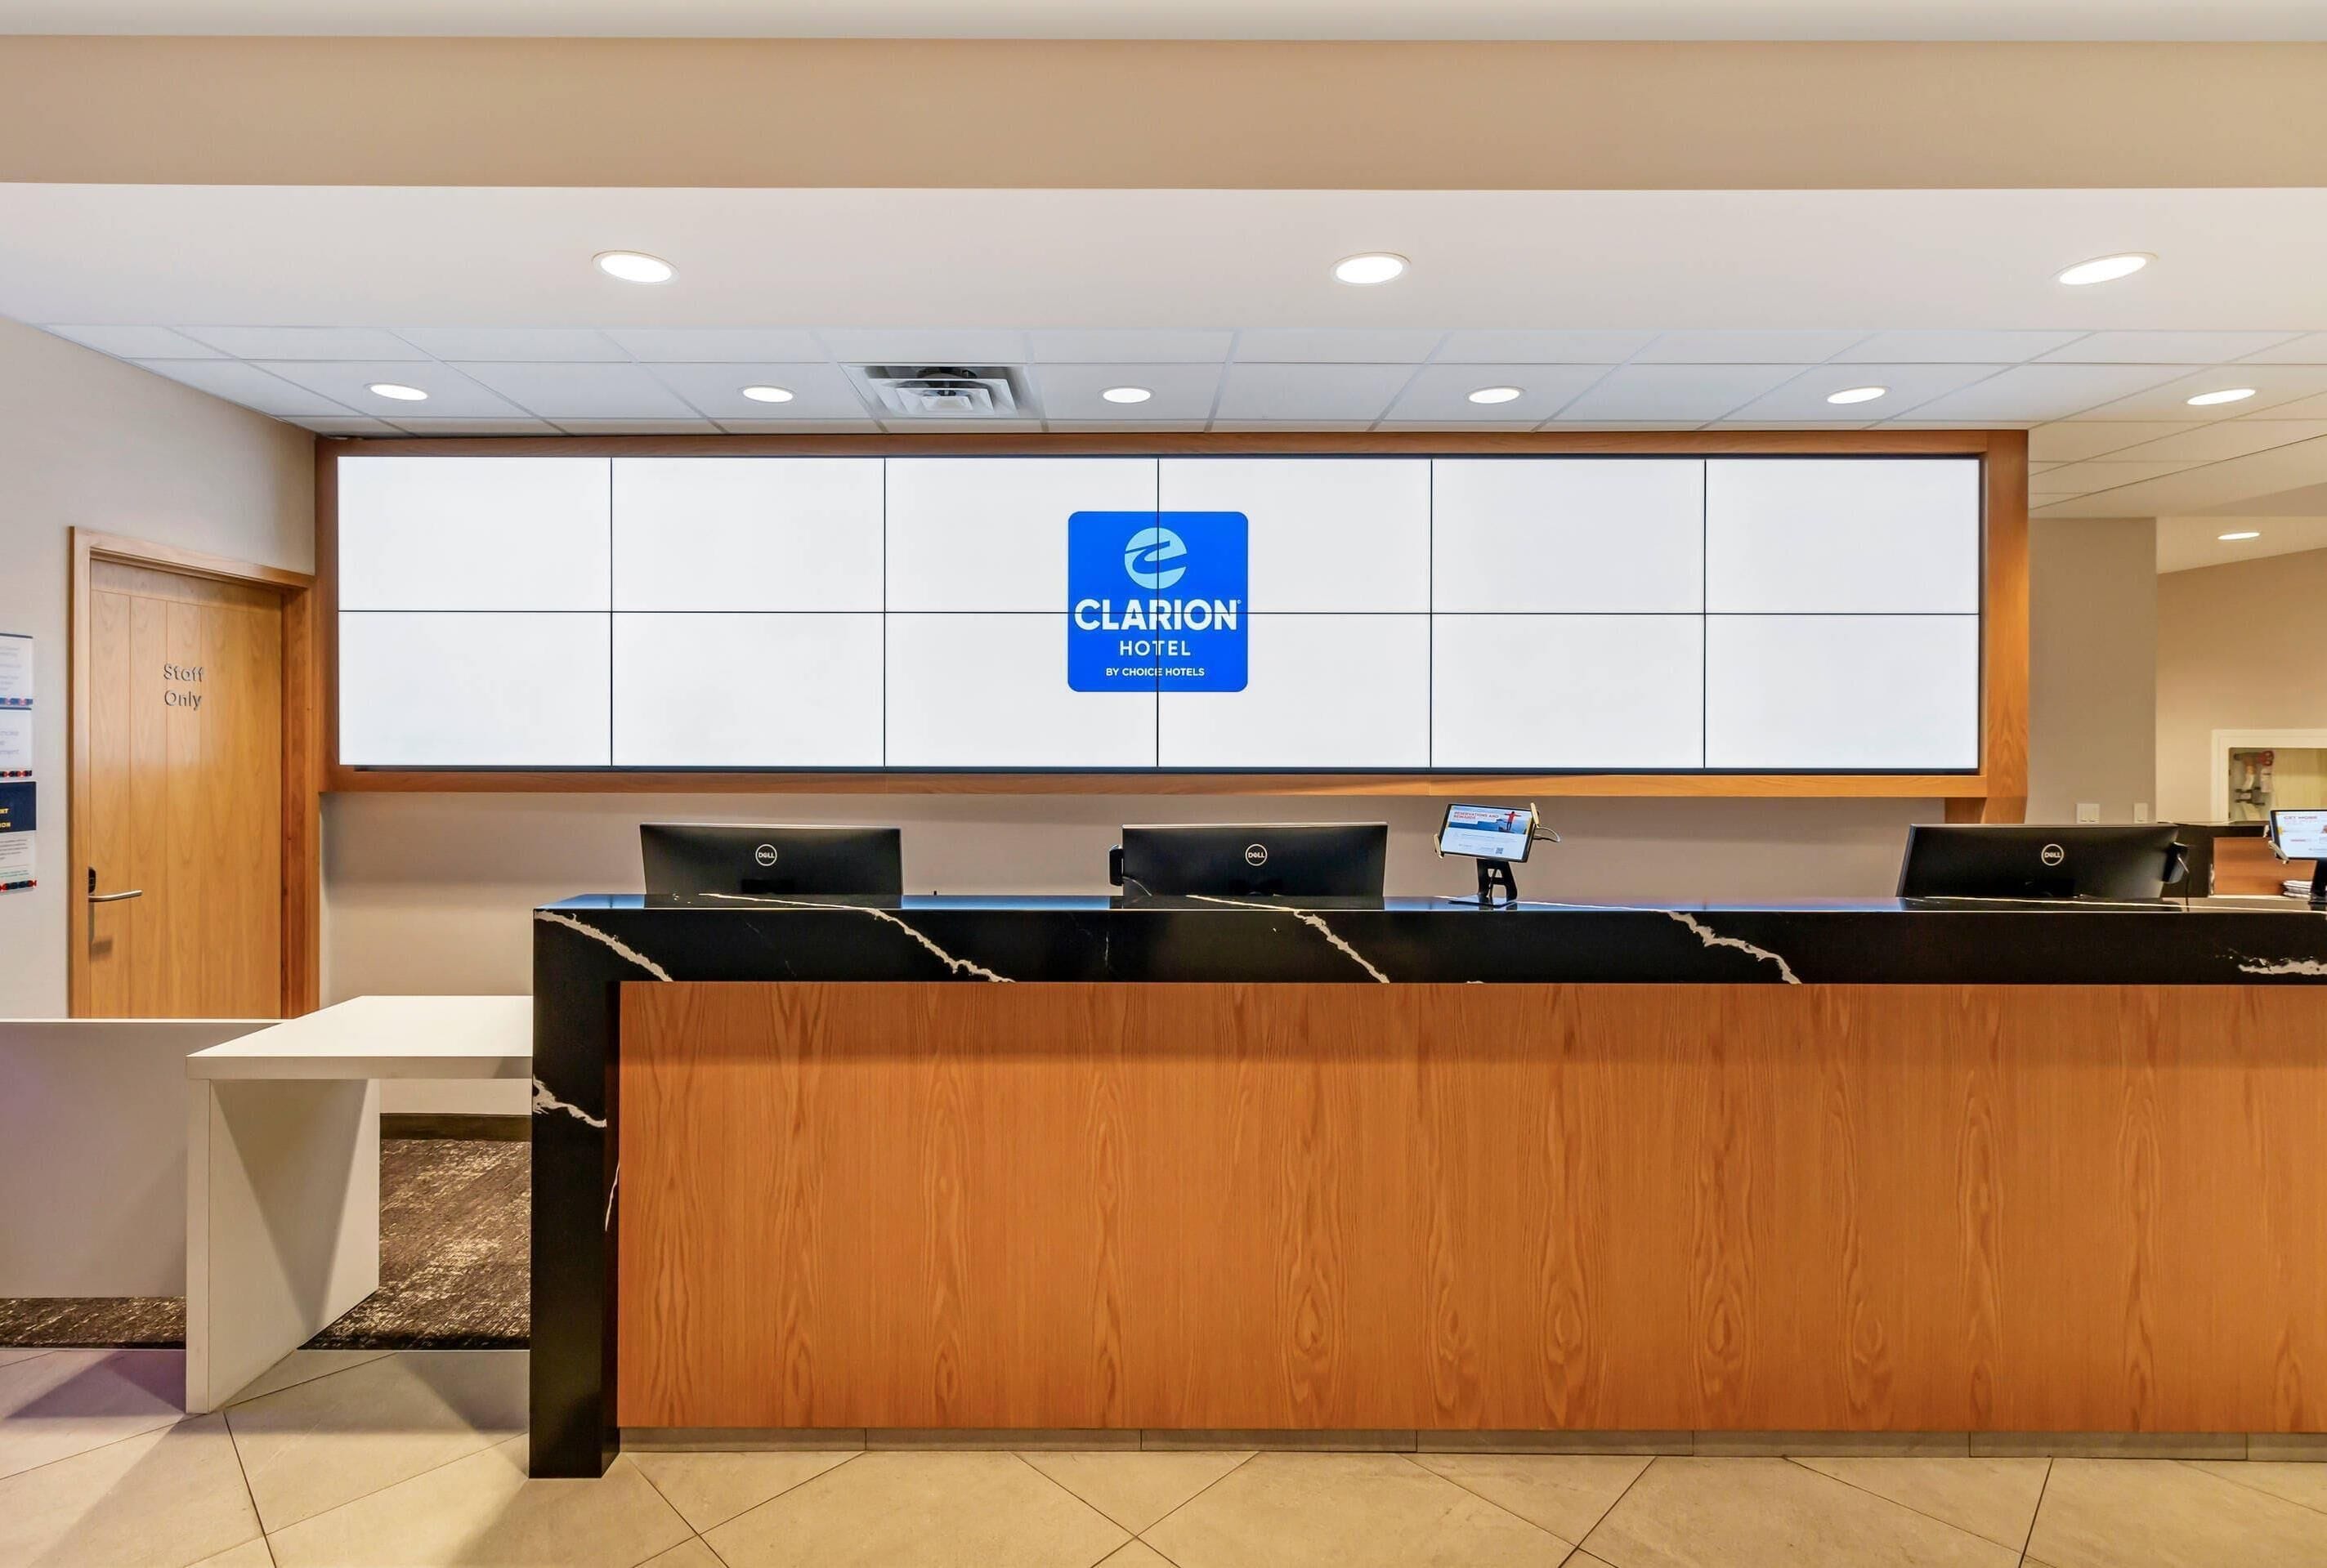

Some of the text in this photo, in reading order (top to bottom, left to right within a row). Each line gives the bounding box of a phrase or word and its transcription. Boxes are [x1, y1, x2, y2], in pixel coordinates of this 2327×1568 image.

[1119, 640, 1191, 656] HOTEL
[163, 663, 203, 682] Staff
[1105, 668, 1206, 677] BY CHOICE HOTELS
[164, 690, 202, 711] Only
